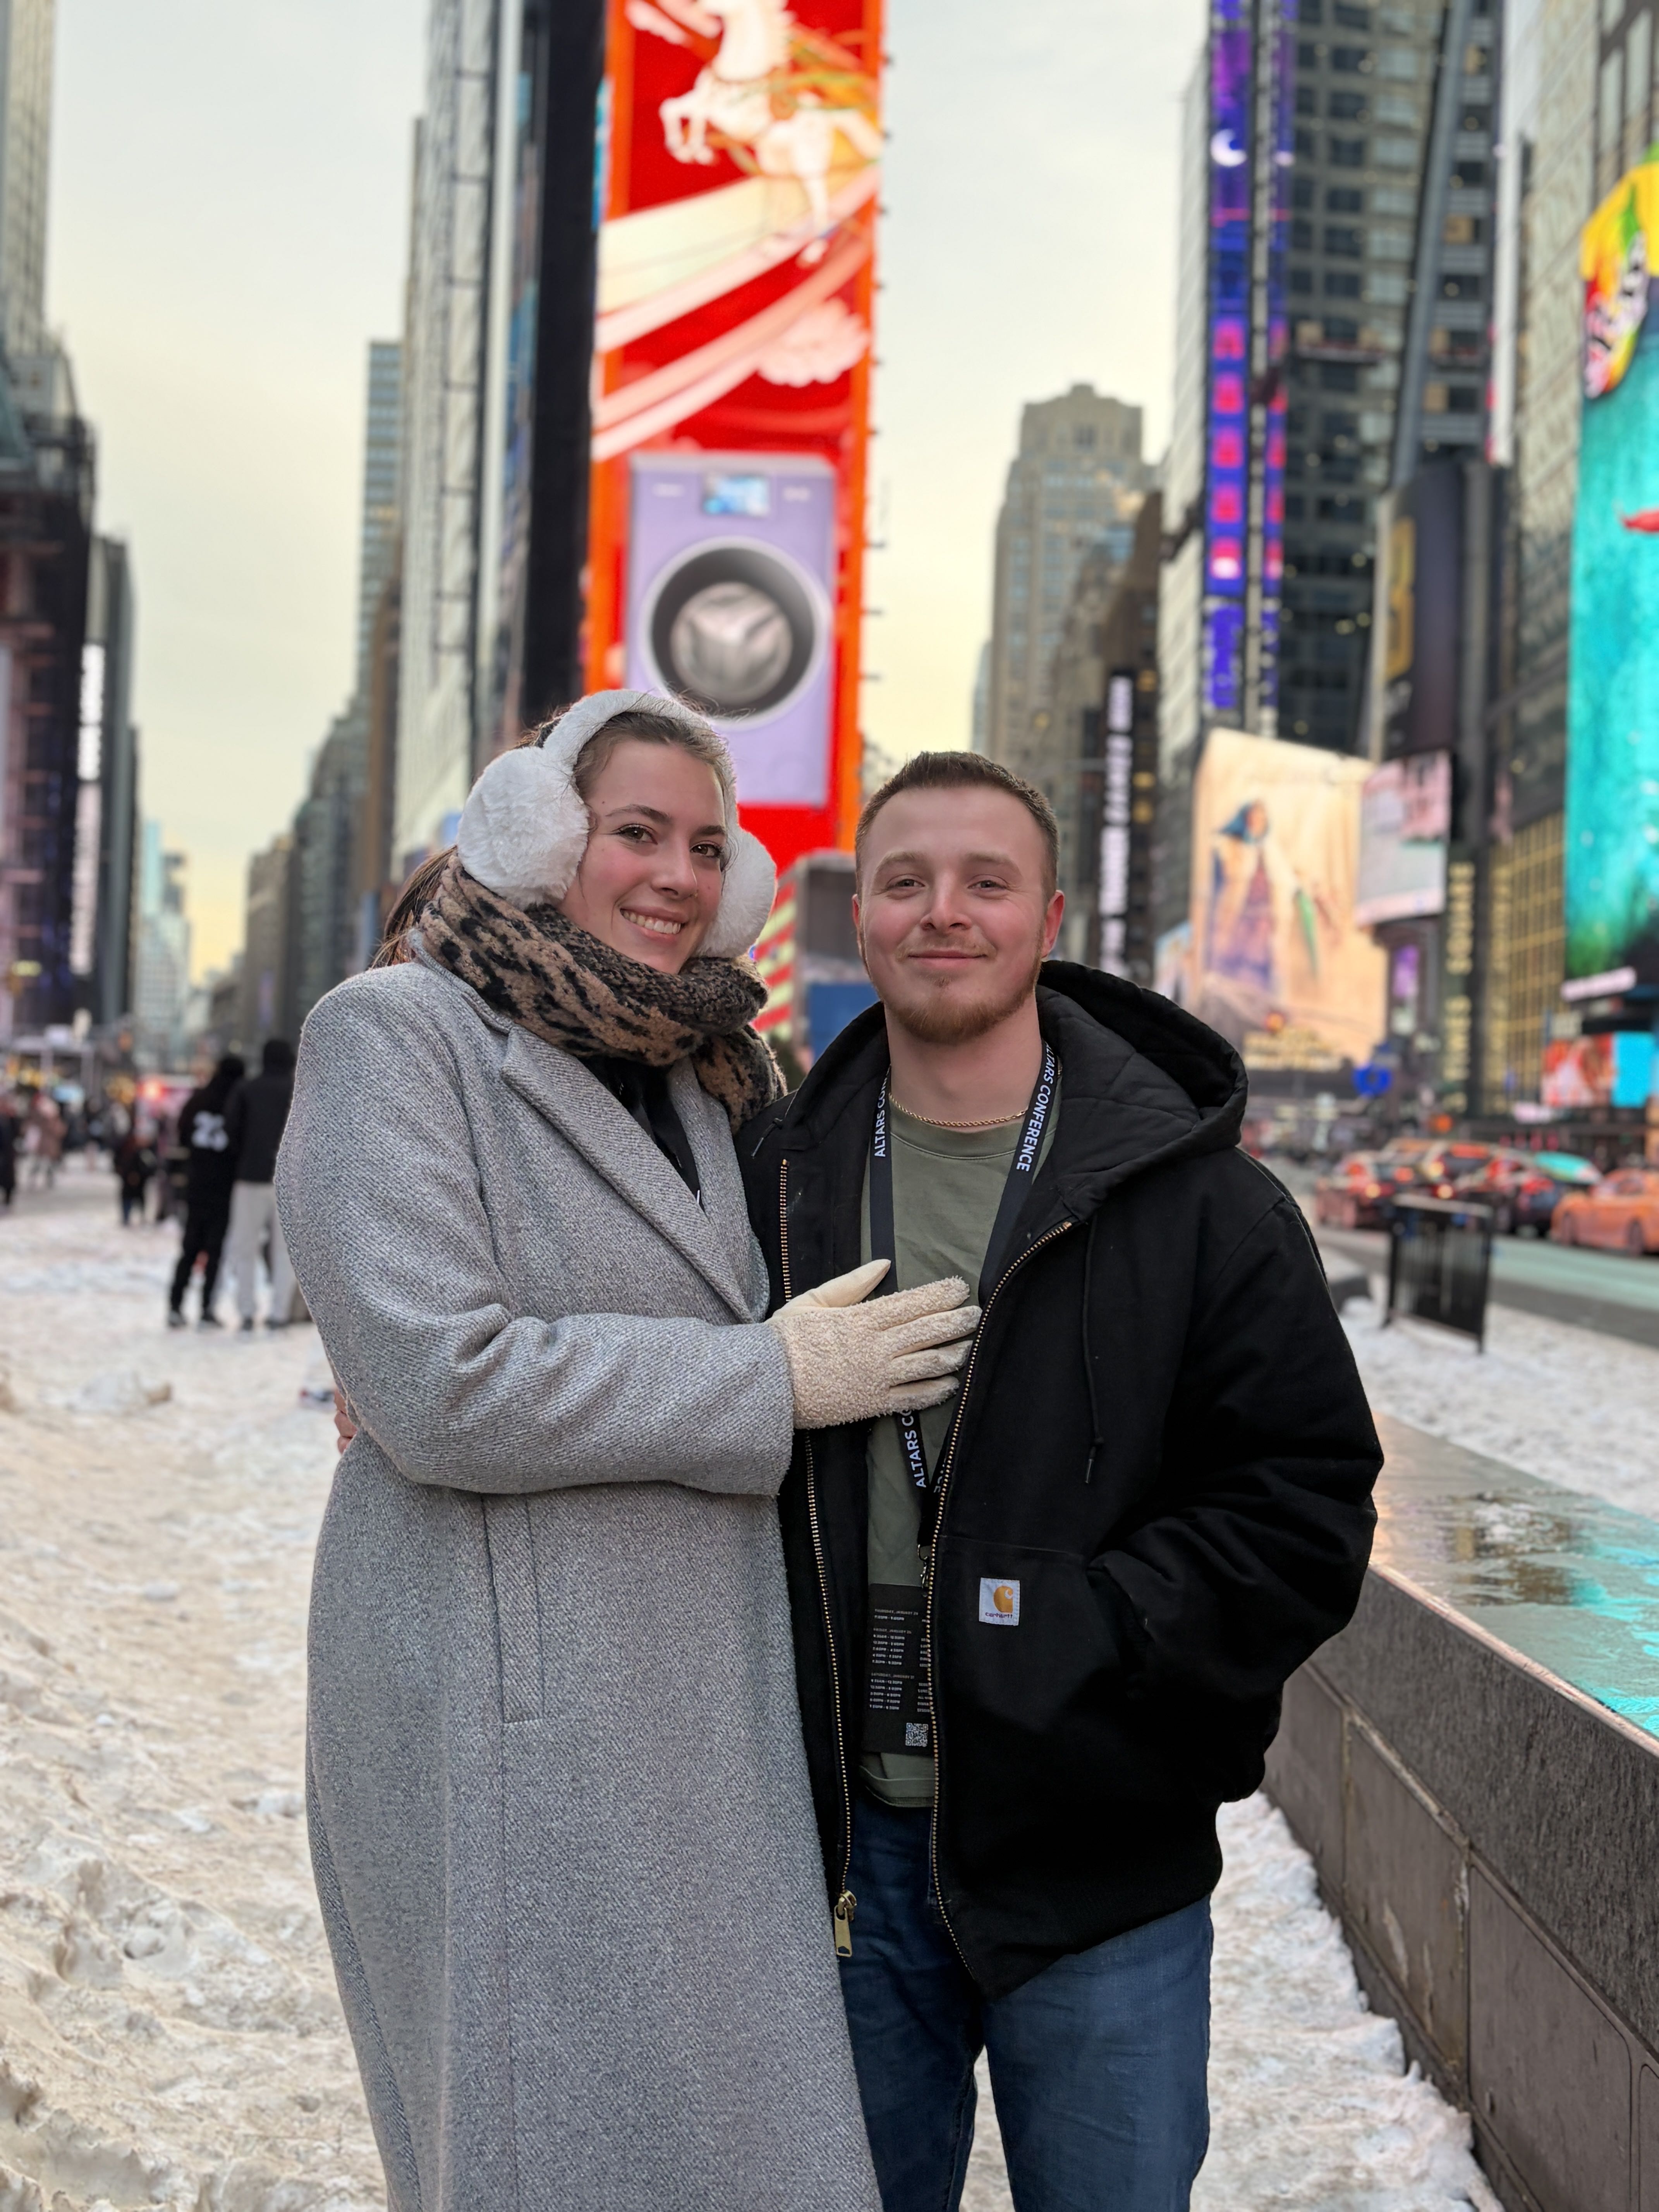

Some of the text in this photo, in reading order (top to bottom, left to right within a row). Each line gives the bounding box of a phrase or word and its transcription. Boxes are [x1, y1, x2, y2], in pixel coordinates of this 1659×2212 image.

[874, 1109, 886, 1157] ALTARS
[1016, 1041, 1055, 1172] ALTARS CONFERENCE
[904, 1430, 926, 1488] ALTARS
